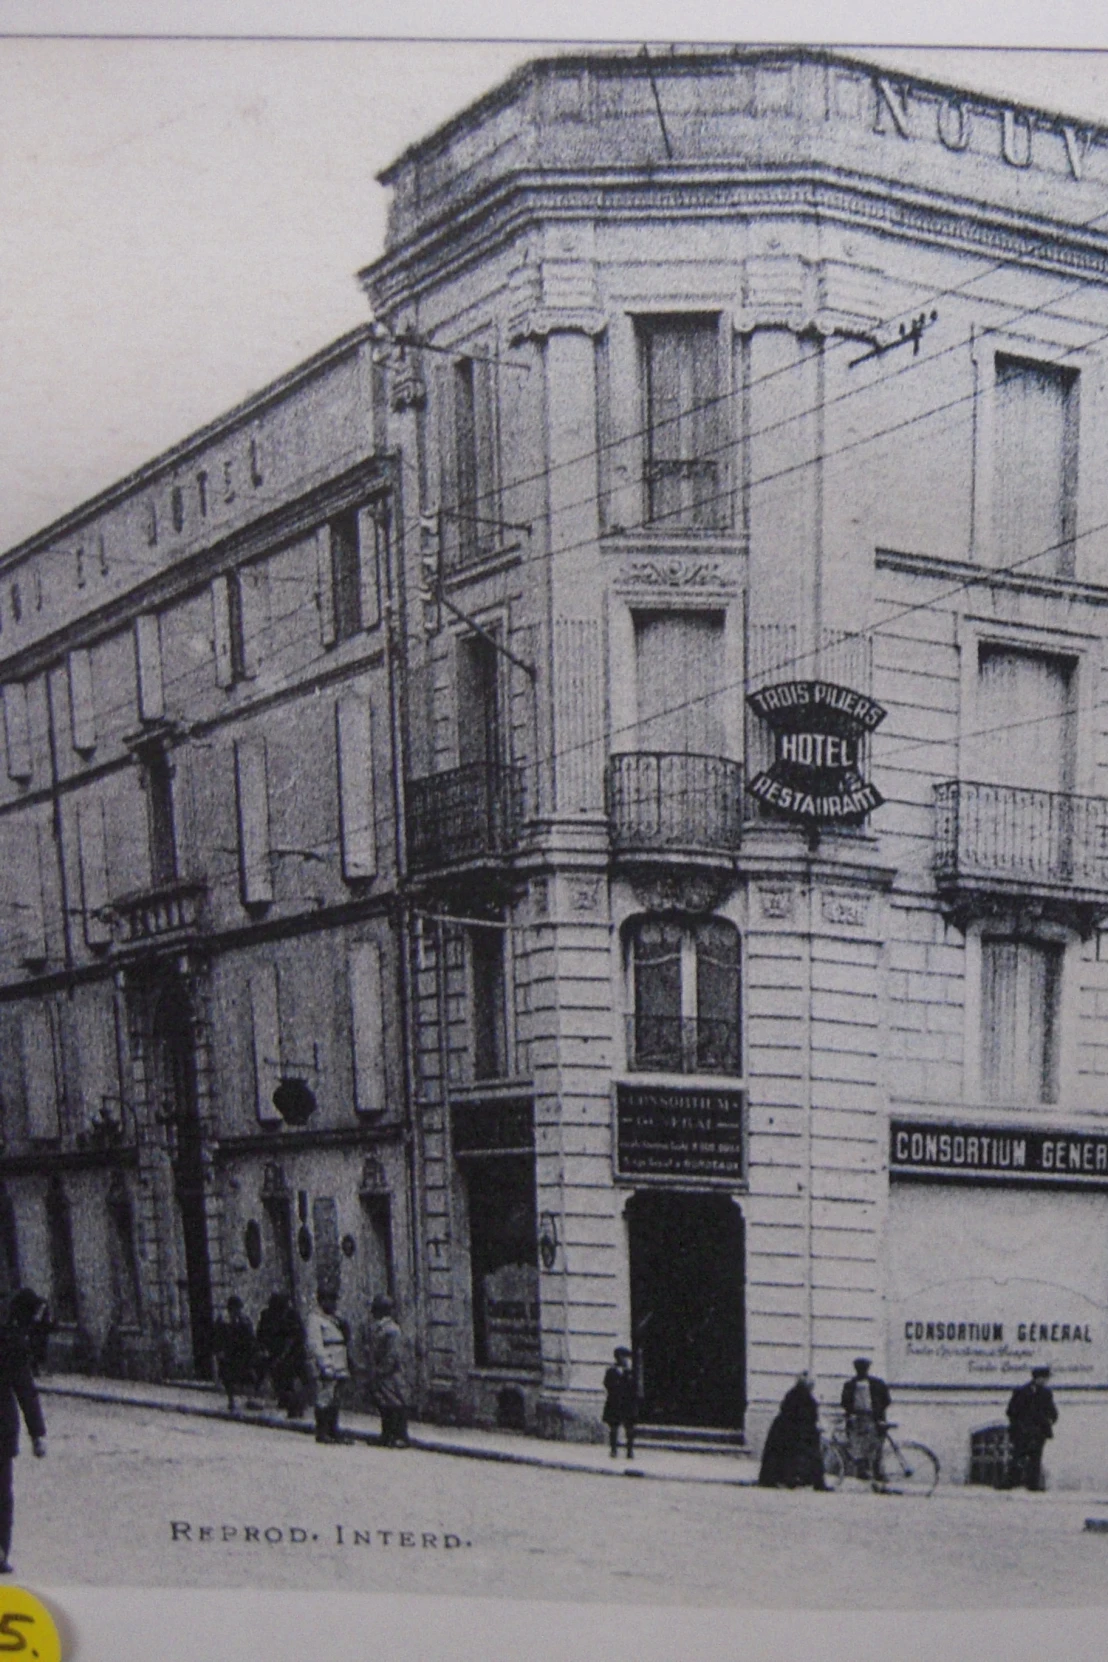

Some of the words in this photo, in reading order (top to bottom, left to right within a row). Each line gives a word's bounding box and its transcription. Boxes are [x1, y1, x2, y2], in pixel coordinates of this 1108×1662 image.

[754, 683, 810, 712] TROIS
[781, 733, 854, 768] HOTEL
[753, 775, 877, 817] RESTAURANT
[896, 1131, 1027, 1167] CONSORTIUM
[905, 1321, 1004, 1341] CONSORTIUM
